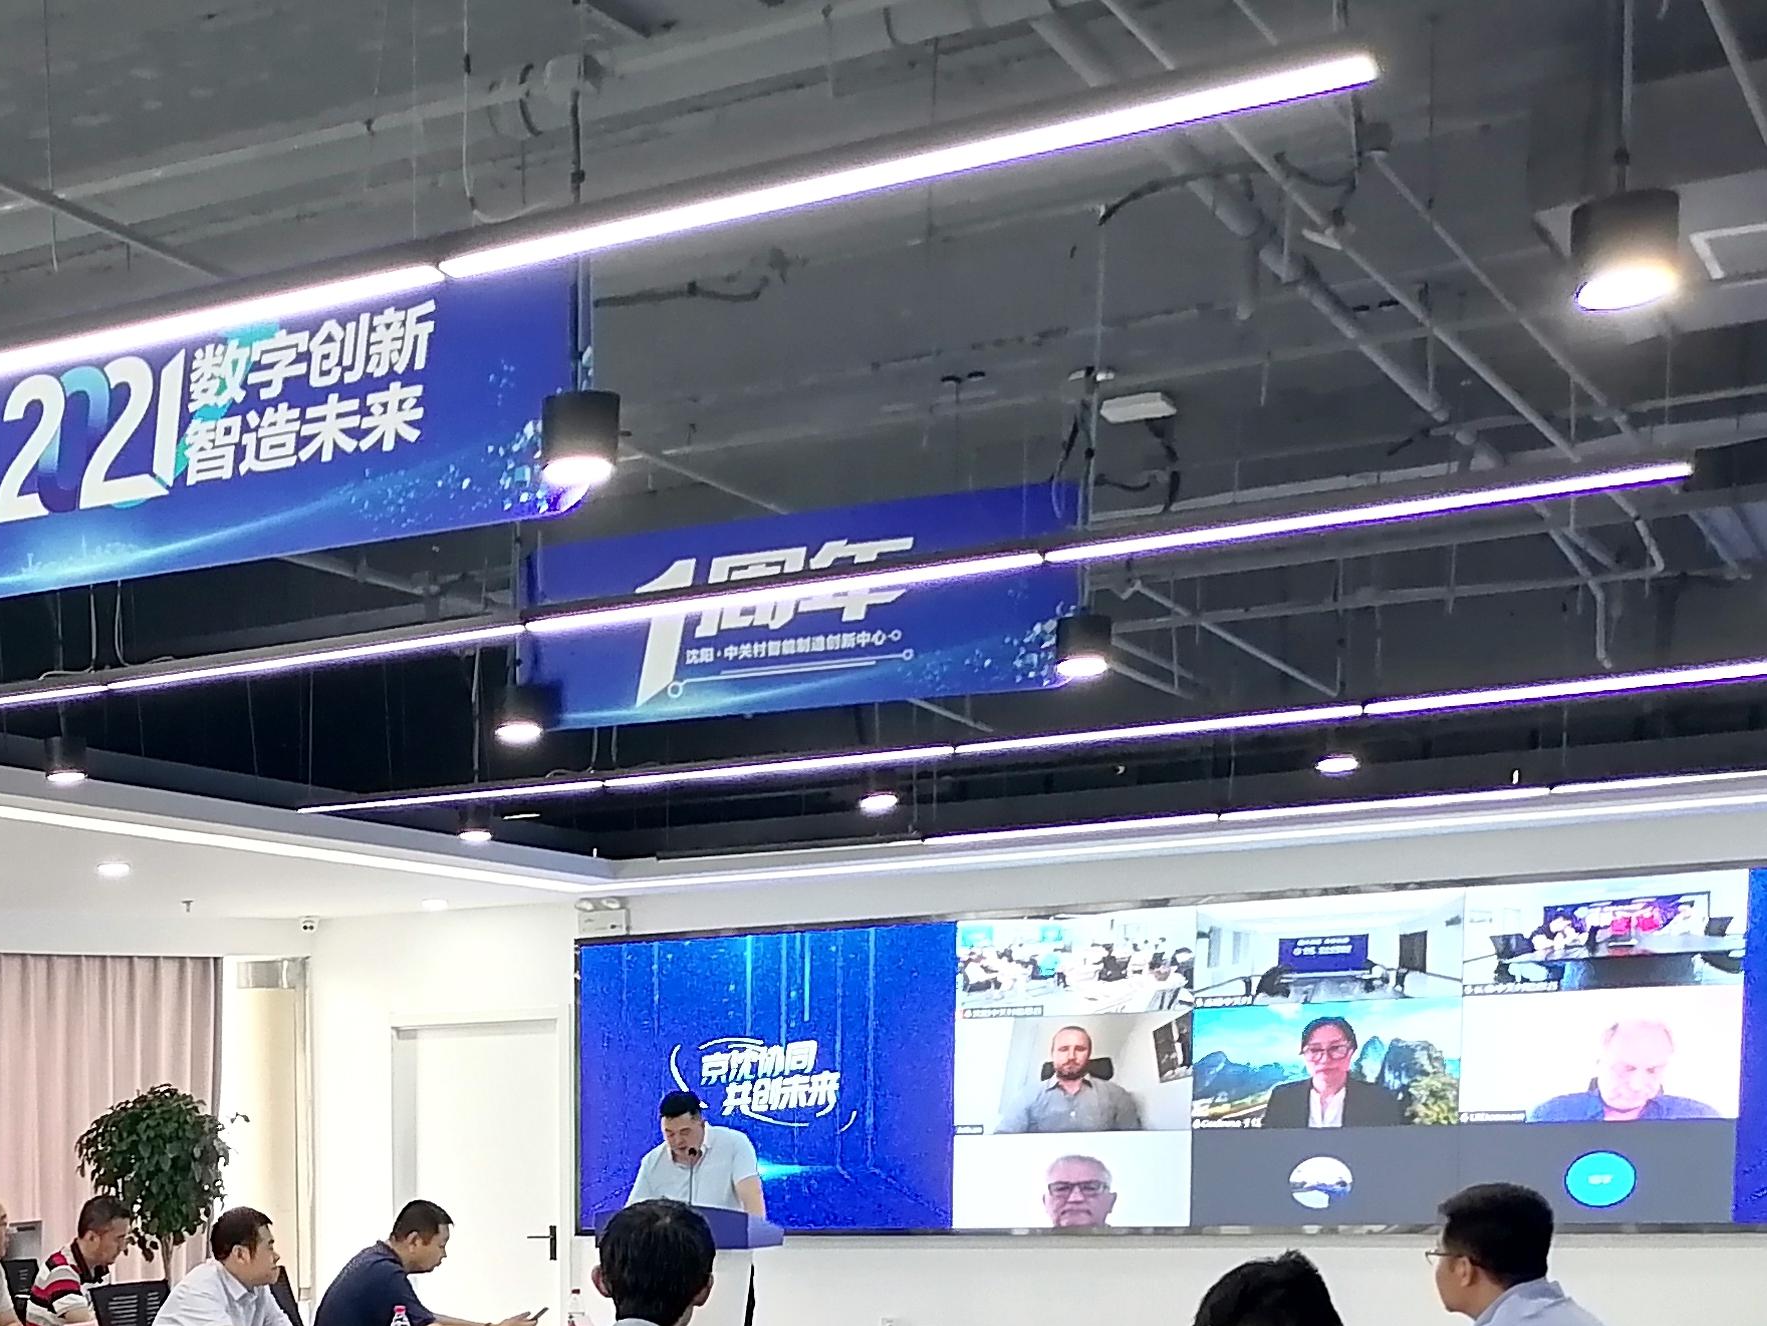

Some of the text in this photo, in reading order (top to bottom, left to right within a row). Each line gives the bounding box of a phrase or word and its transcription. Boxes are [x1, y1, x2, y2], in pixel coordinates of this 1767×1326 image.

[188, 299, 436, 411] 数字创新
[184, 381, 424, 486] 智造未来
[721, 1070, 841, 1117] 共创未来
